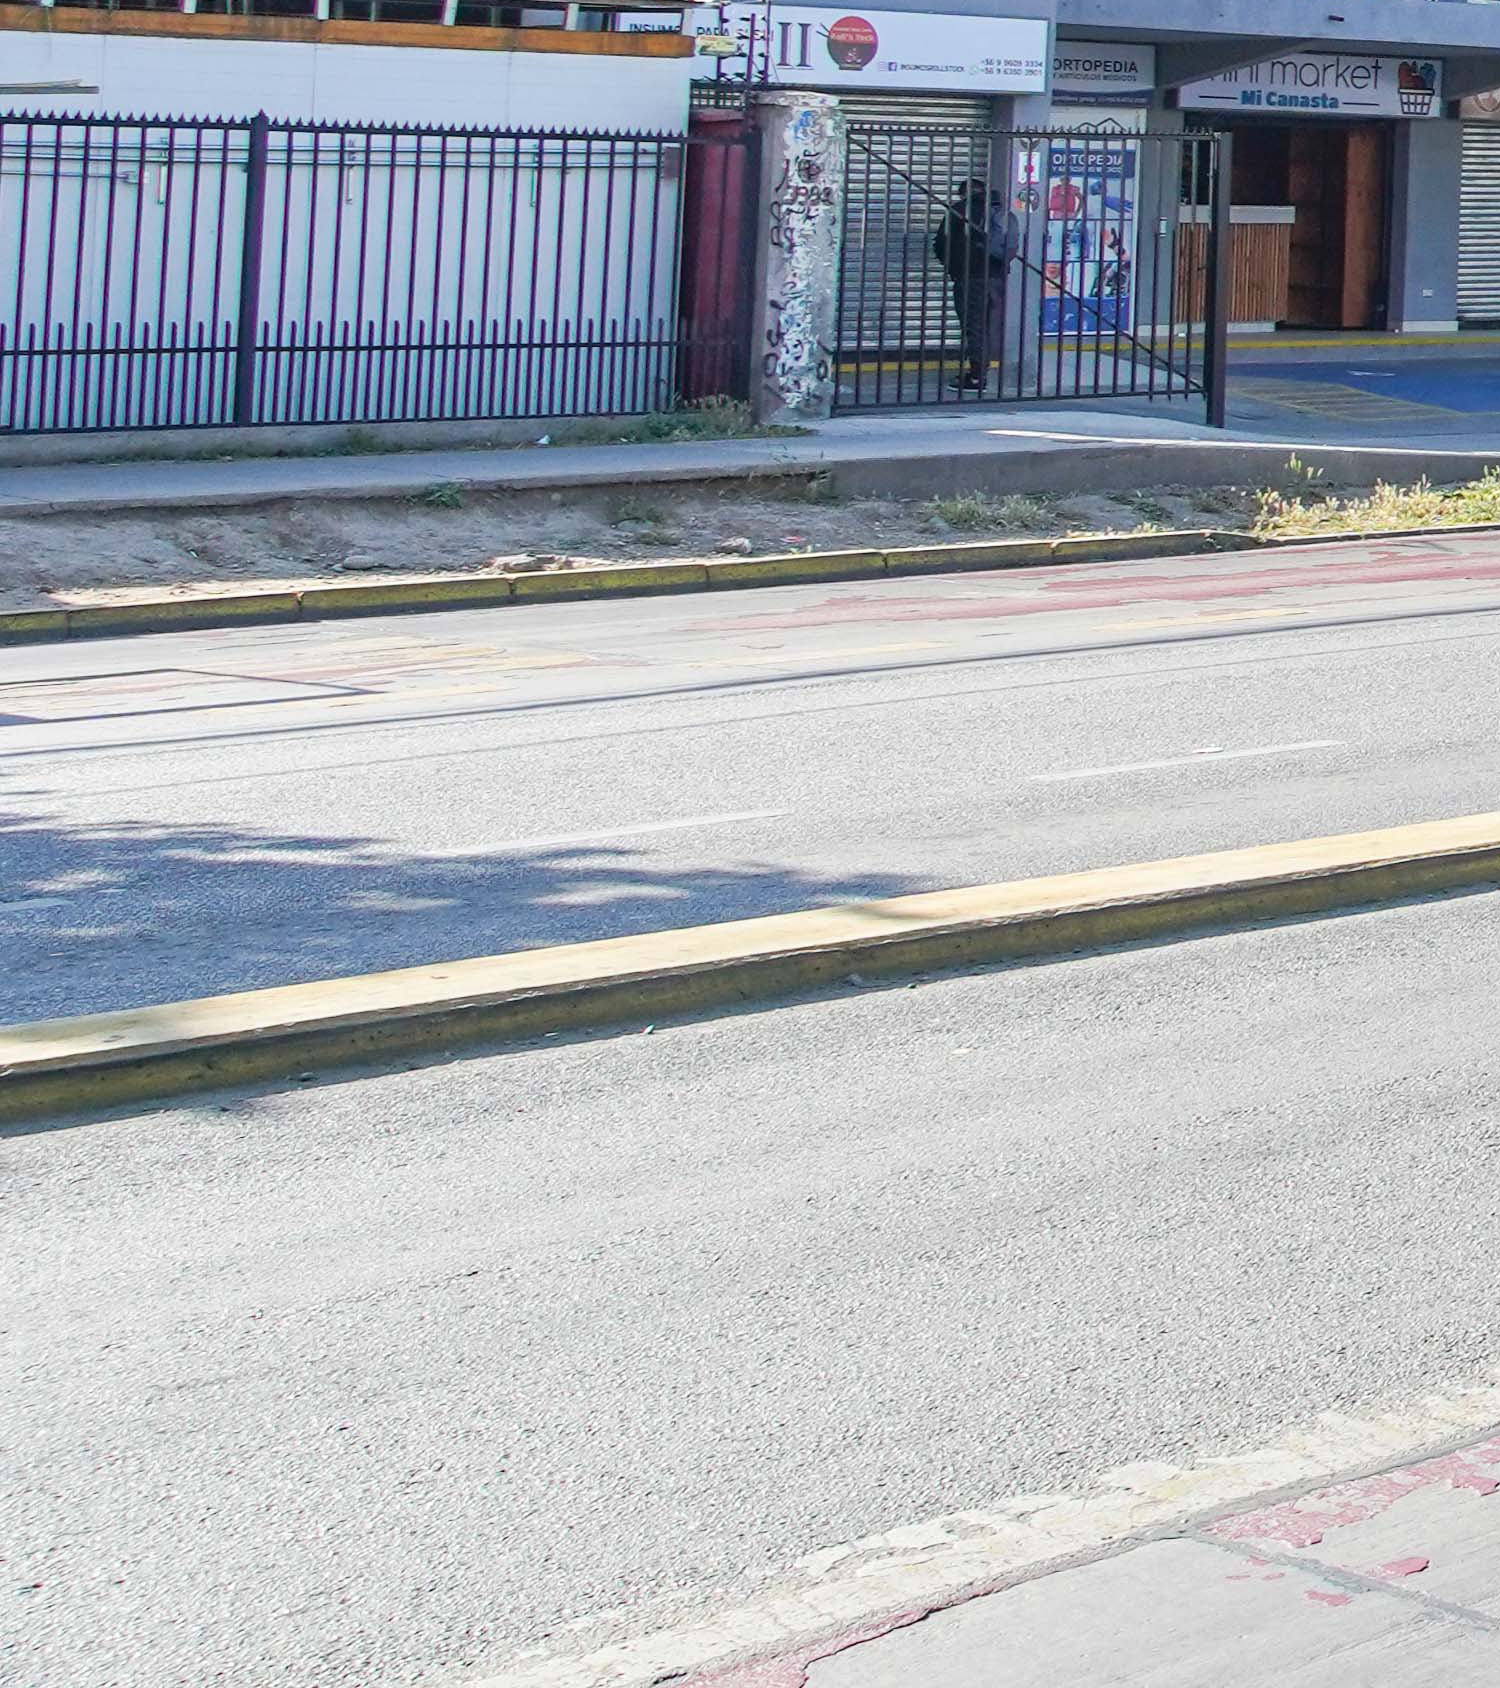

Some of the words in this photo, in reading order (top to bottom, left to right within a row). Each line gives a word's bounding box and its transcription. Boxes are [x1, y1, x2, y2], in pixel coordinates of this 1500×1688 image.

[1053, 58, 1139, 74] ORTOPEDIA
[1270, 56, 1383, 90] market
[1241, 89, 1262, 106] Mi
[1265, 91, 1340, 110] Canasta
